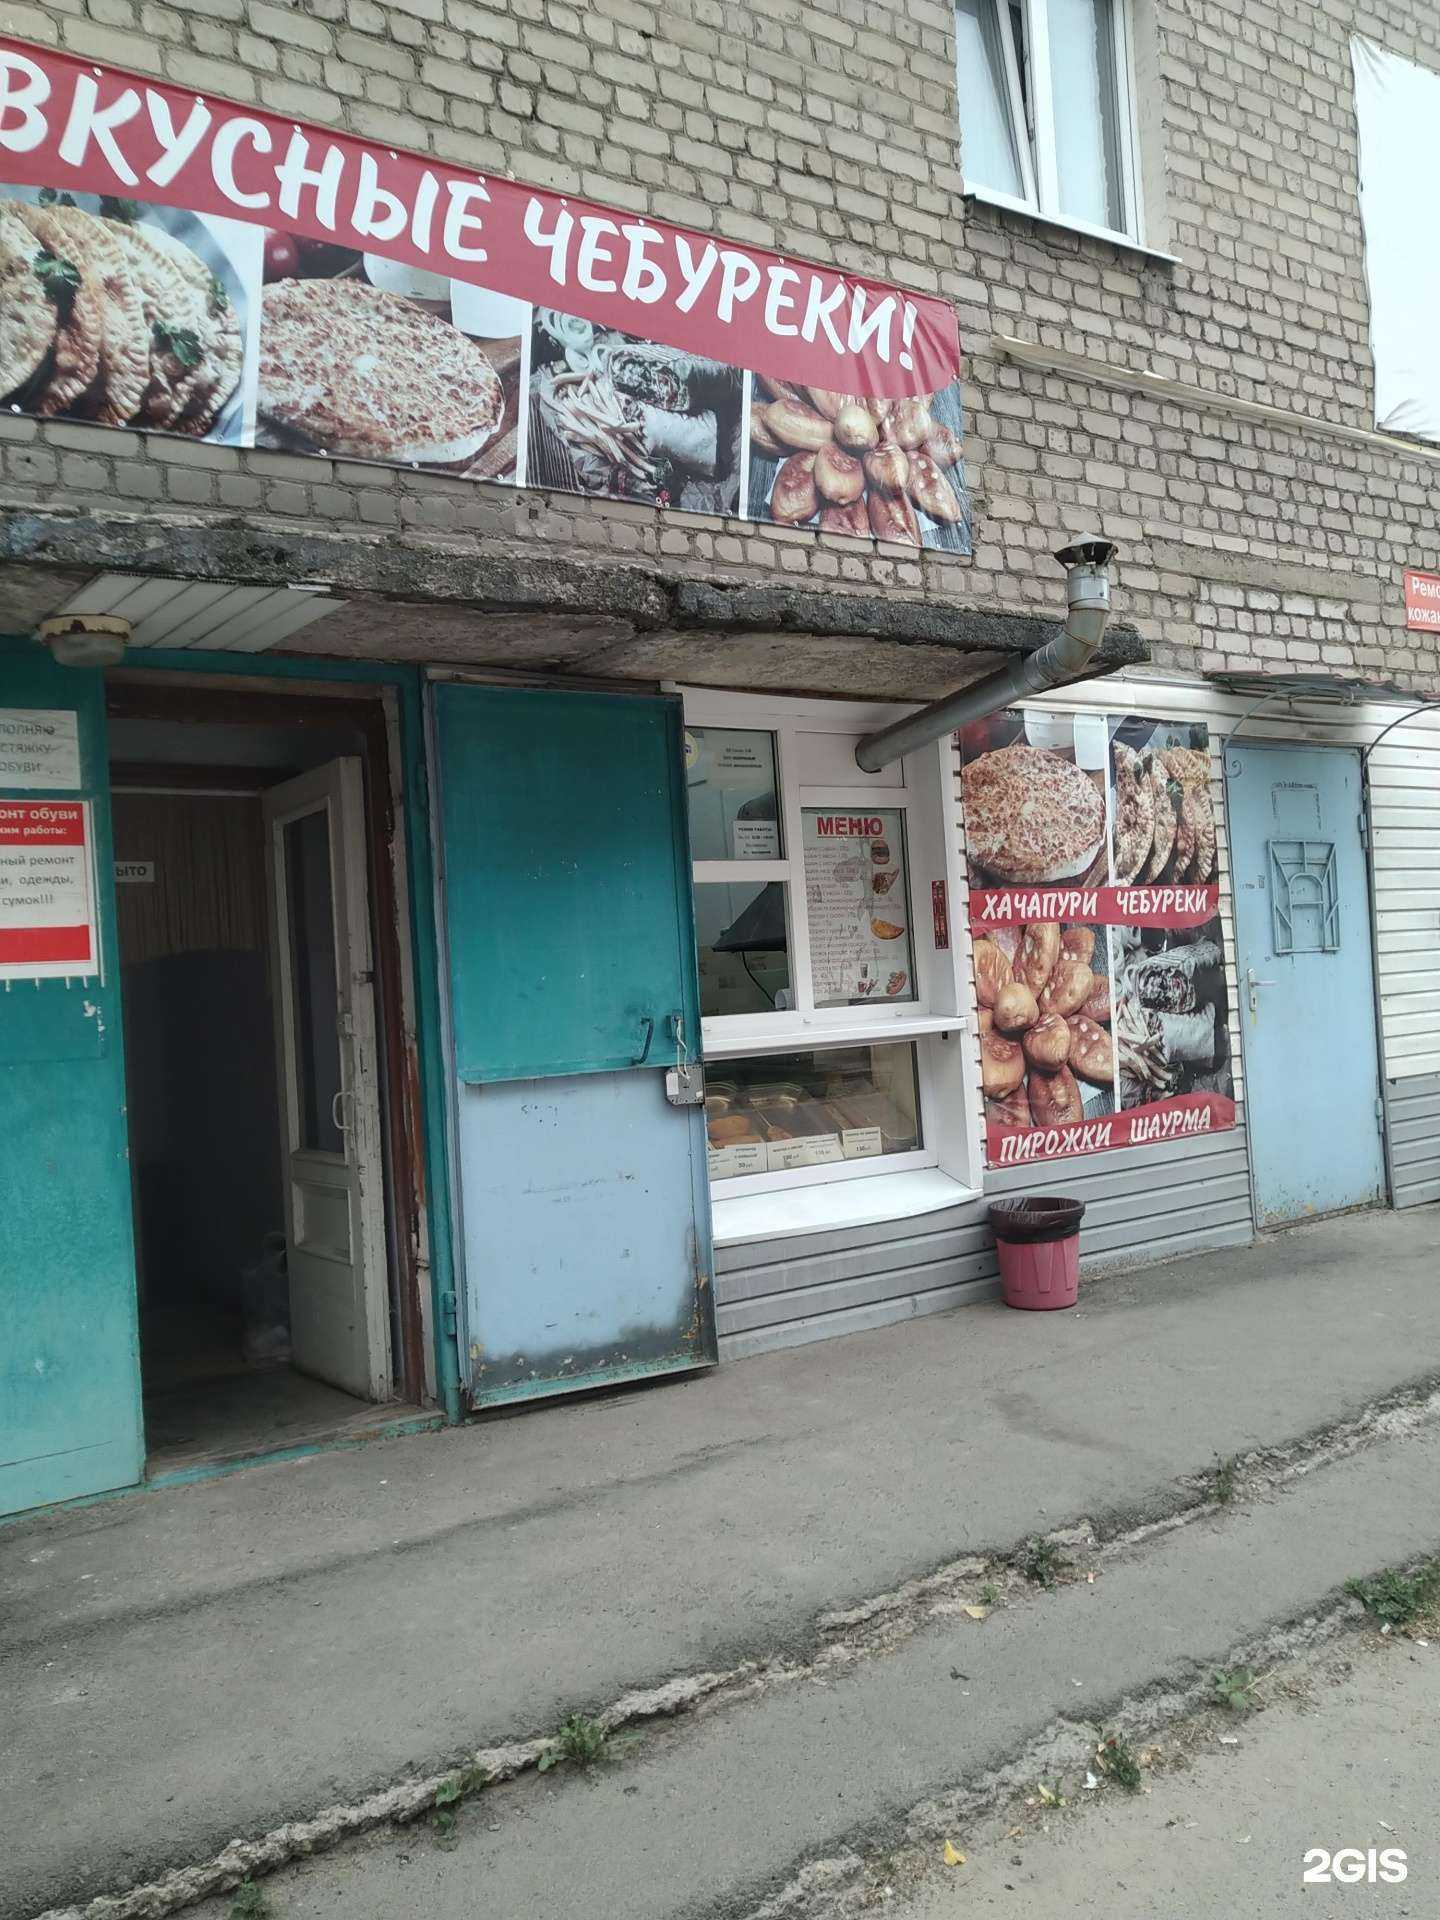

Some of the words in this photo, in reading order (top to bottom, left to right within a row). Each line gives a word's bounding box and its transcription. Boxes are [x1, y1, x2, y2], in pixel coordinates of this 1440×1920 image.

[0, 50, 491, 263] ВКУСНЫЕ
[523, 197, 917, 371] ЧЕБУРЕКИ!
[30, 807, 78, 822] обуви
[23, 825, 67, 837] работы:
[817, 816, 883, 835] МЕНЮ
[30, 857, 75, 867] ремонт
[981, 892, 1098, 920] ХАЧАПУРИ
[1116, 888, 1208, 915] ЧЕБУРЕКИ
[1000, 1121, 1113, 1162] ПИРОЖКИ
[1130, 1105, 1212, 1143] ШАУРМА
